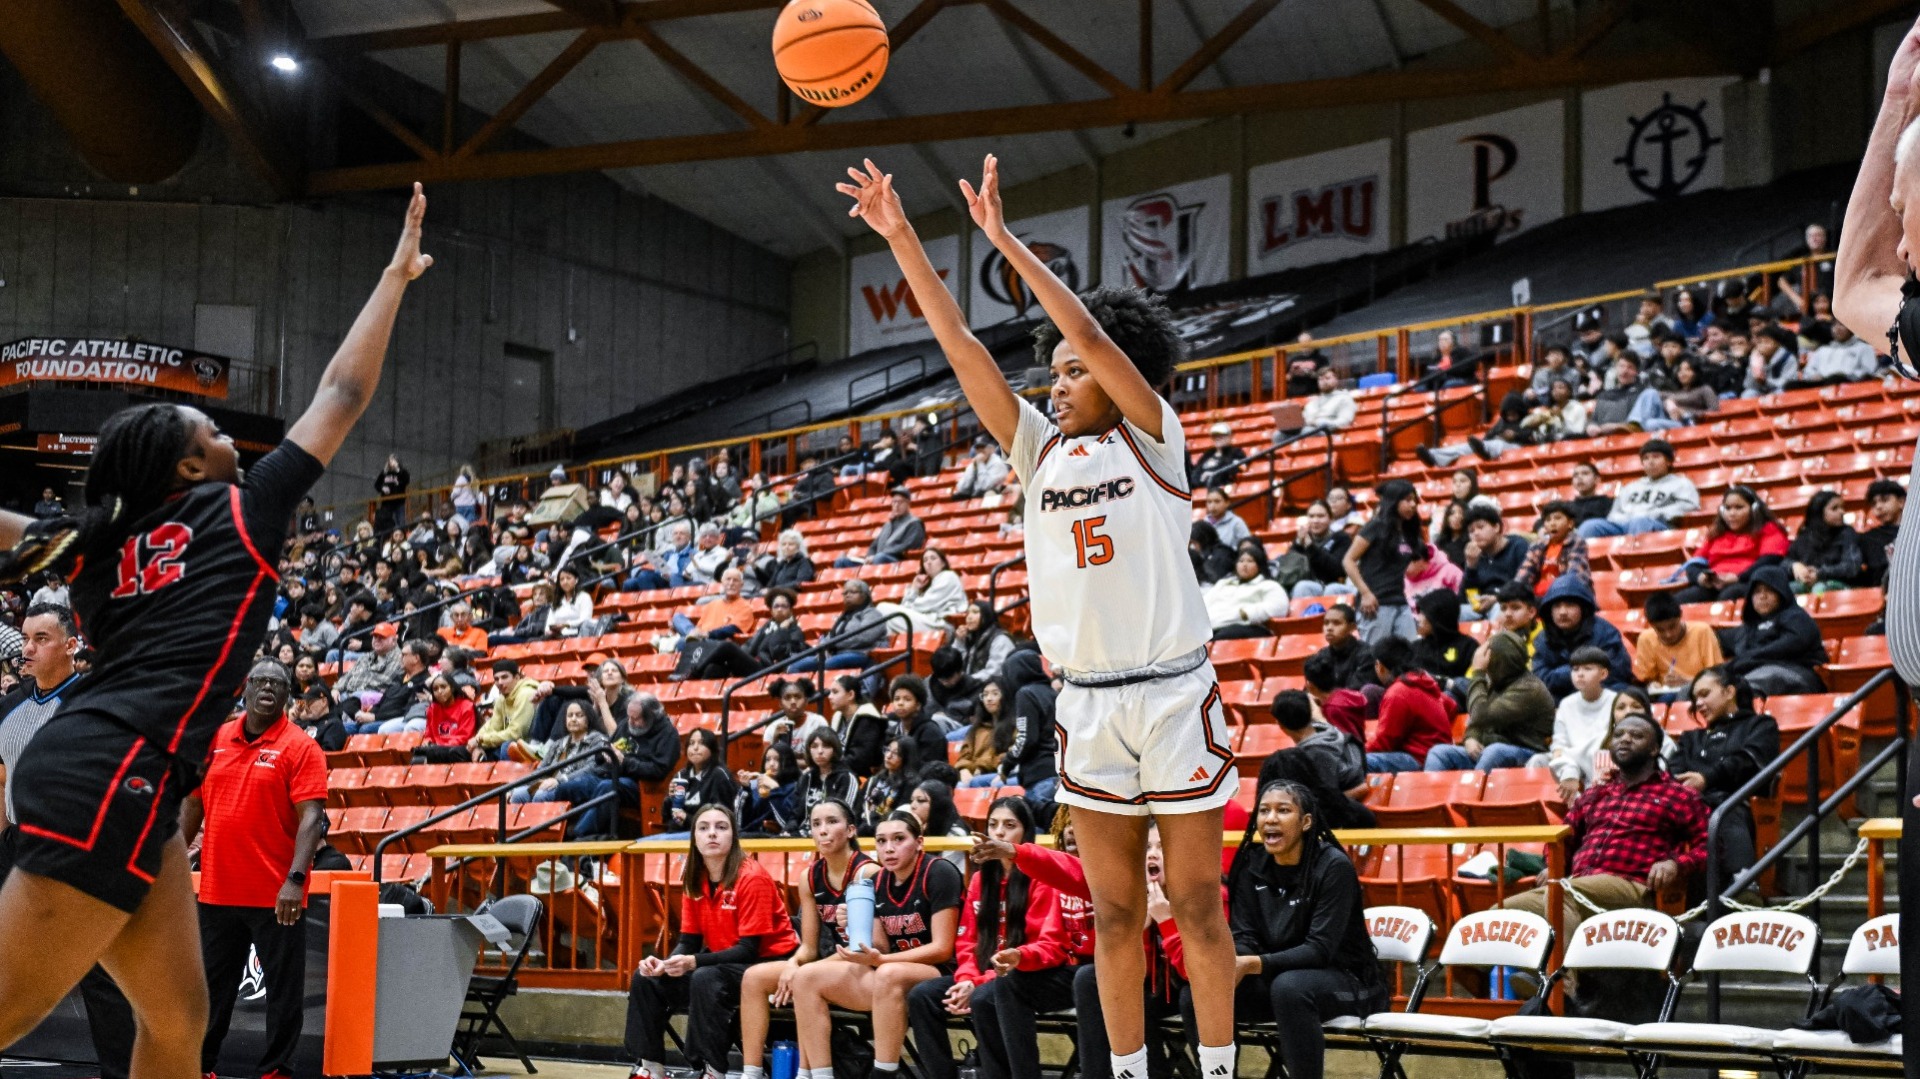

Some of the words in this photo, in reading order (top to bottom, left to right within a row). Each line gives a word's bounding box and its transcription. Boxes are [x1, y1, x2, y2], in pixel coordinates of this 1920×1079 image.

[796, 71, 873, 101] Wilson
[1258, 175, 1378, 260] LMU
[1, 339, 66, 362] PACIFIC
[69, 339, 183, 367] ATHLETIC
[15, 360, 157, 383] FOUNDATION
[1041, 475, 1135, 513] PACIFIC
[1071, 515, 1114, 569] 15
[110, 521, 193, 599] 12
[1459, 920, 1538, 949] PACIFIC
[1583, 919, 1667, 948] PACIFIC
[1712, 922, 1805, 952] PACIFIC
